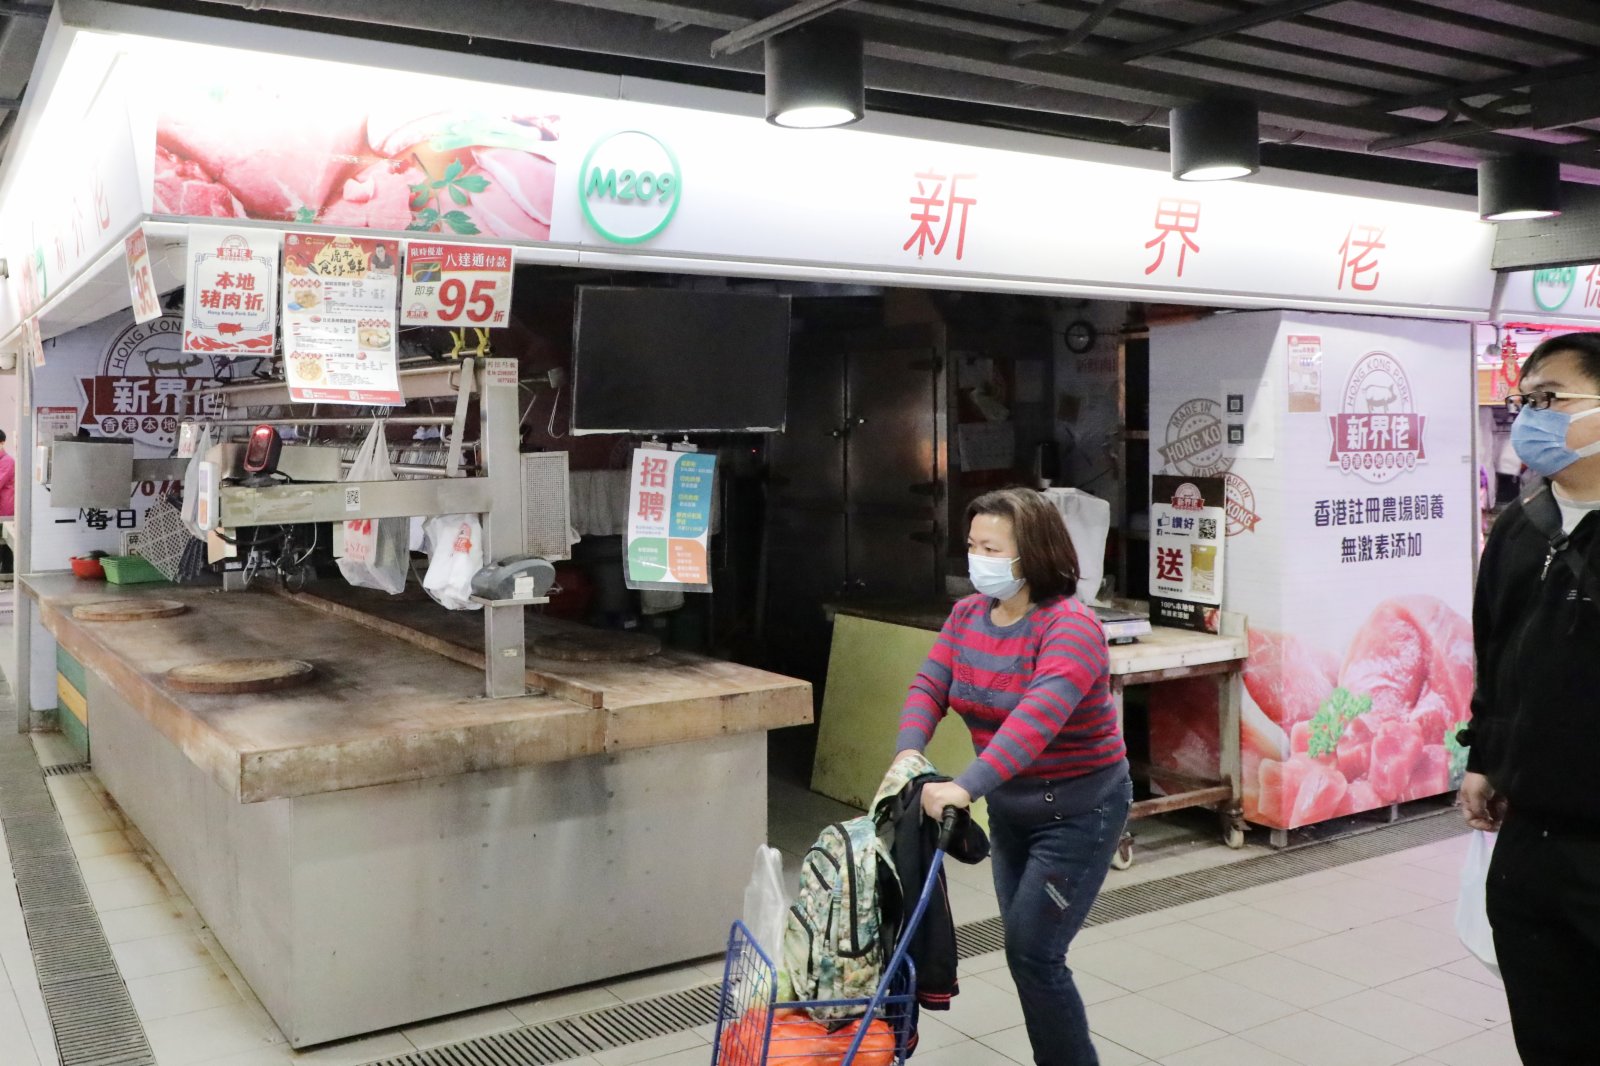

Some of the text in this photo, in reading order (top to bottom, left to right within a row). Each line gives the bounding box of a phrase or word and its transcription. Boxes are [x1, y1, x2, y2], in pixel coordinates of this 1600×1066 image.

[586, 166, 676, 203] M209
[899, 166, 1387, 291] 新界佬
[410, 246, 444, 257] 限時優惠
[445, 252, 508, 268] 八達通付款
[215, 271, 256, 290] 本地
[414, 285, 435, 296] 即享
[436, 278, 497, 323] 95
[493, 310, 505, 323] 折
[112, 320, 184, 369] HONG KON
[1346, 368, 1366, 407] HONG
[1366, 357, 1392, 374] KONG
[1171, 399, 1212, 428] MADE IN
[1165, 424, 1221, 464] HONG KO
[1346, 415, 1410, 450] 新界佬
[637, 456, 668, 522] 招聘
[1171, 515, 1195, 530] 讚好
[1226, 501, 1254, 528] KONG
[1314, 494, 1445, 527] 香港註冊農場飼養
[1156, 546, 1184, 582] 送
[1341, 532, 1422, 564] 無激素添加
